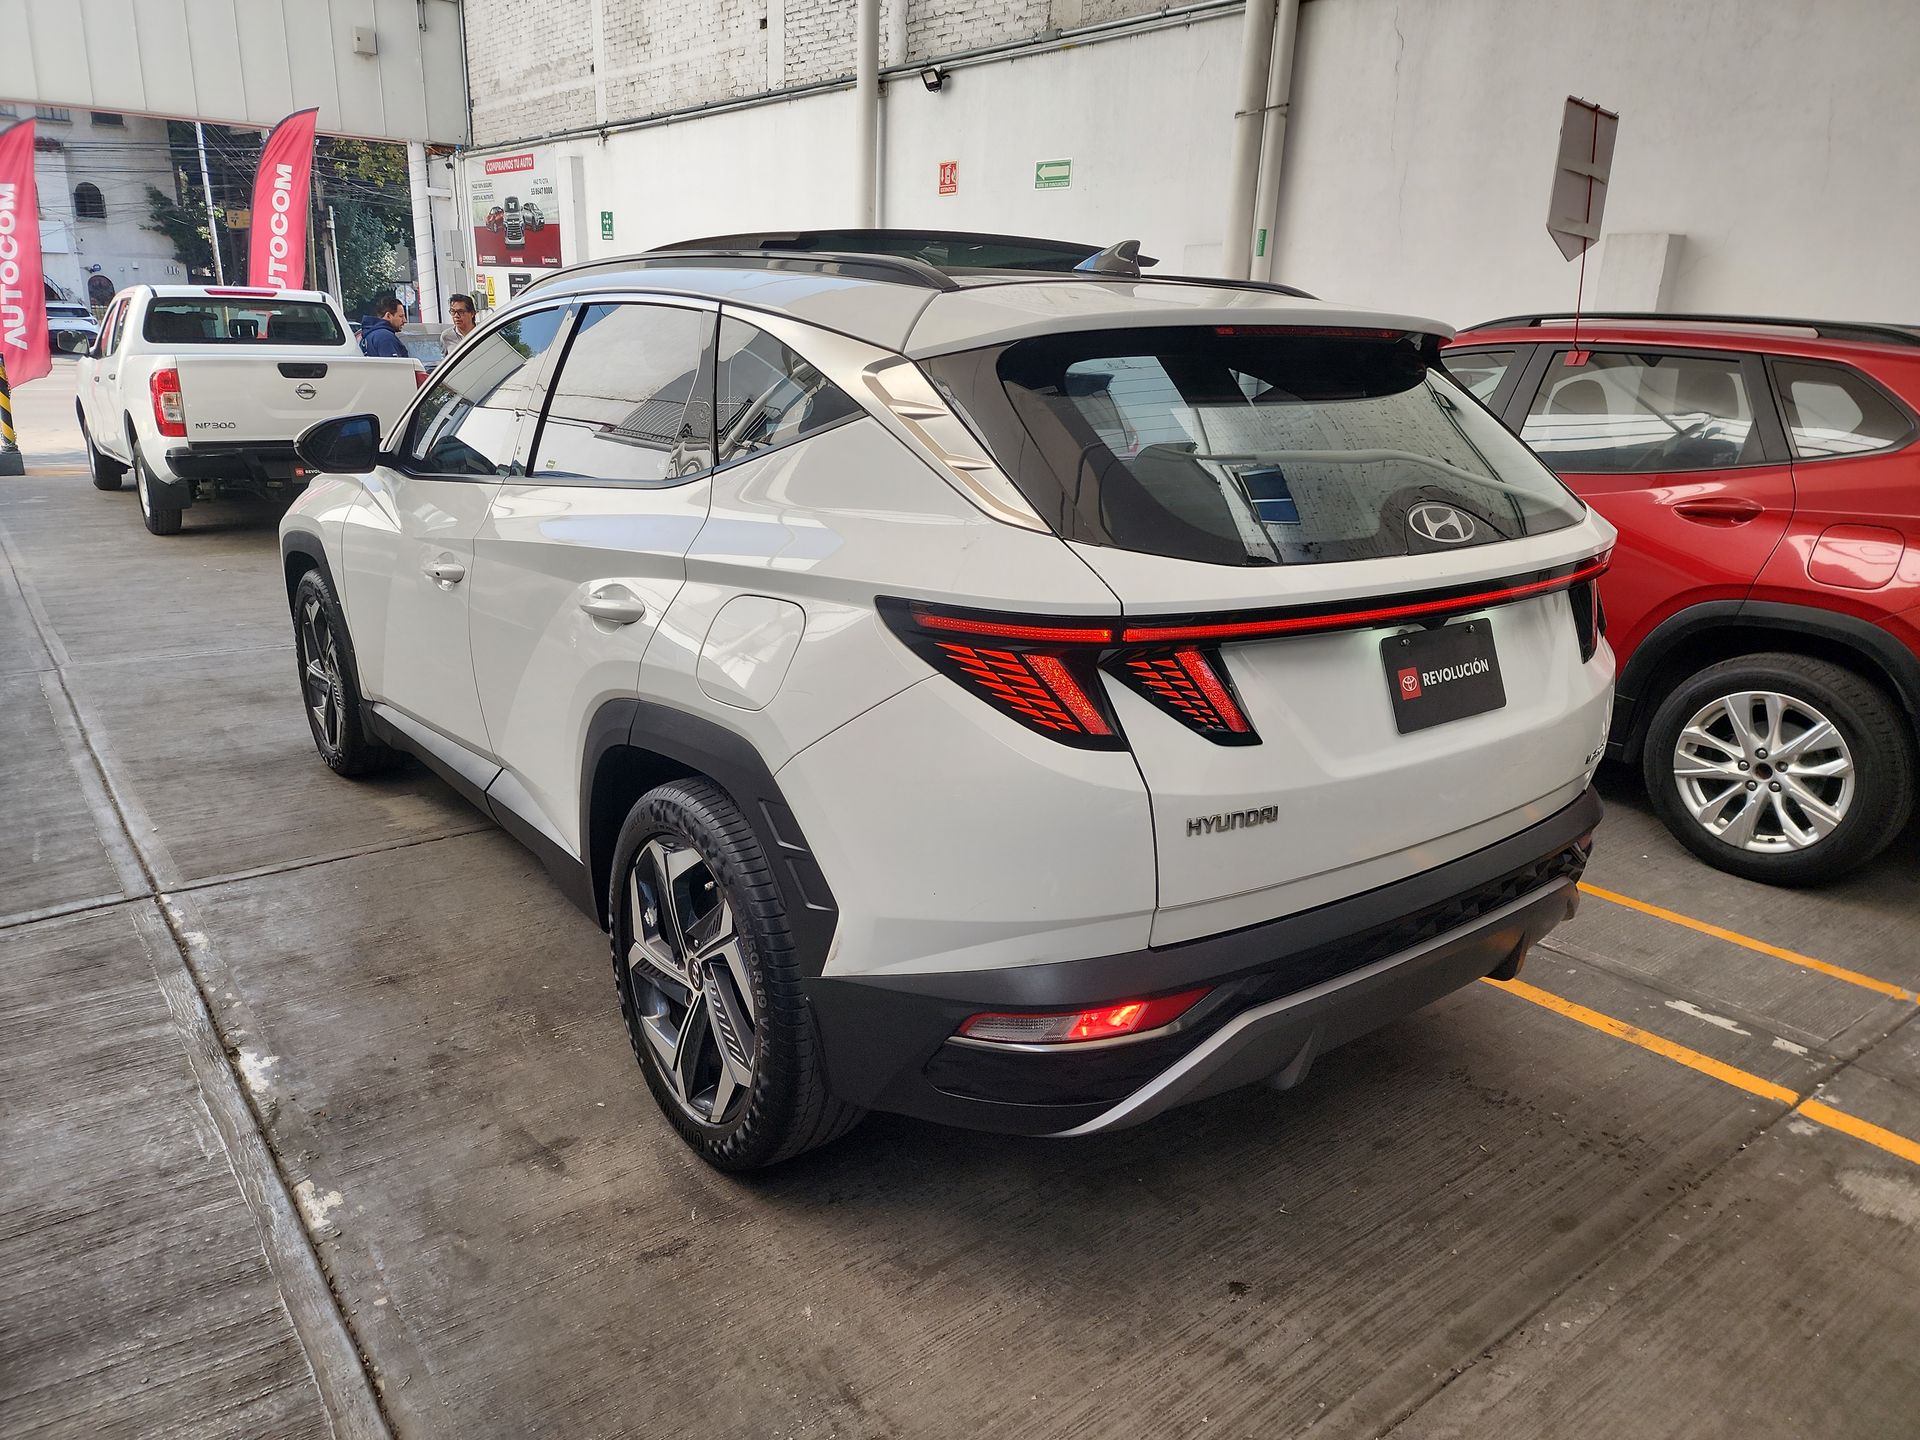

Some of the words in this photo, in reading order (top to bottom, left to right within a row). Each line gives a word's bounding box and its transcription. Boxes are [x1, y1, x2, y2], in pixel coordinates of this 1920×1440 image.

[486, 160, 513, 172] COMPRAMOS
[514, 159, 520, 169] TU
[520, 157, 532, 168] AUTO
[268, 163, 293, 290] UTOCOM
[0, 183, 28, 350] AUTOCOM
[1422, 658, 1490, 687] REVOLUCIÓN
[1186, 804, 1278, 837] HYUNDAI
[756, 988, 767, 1009] 19
